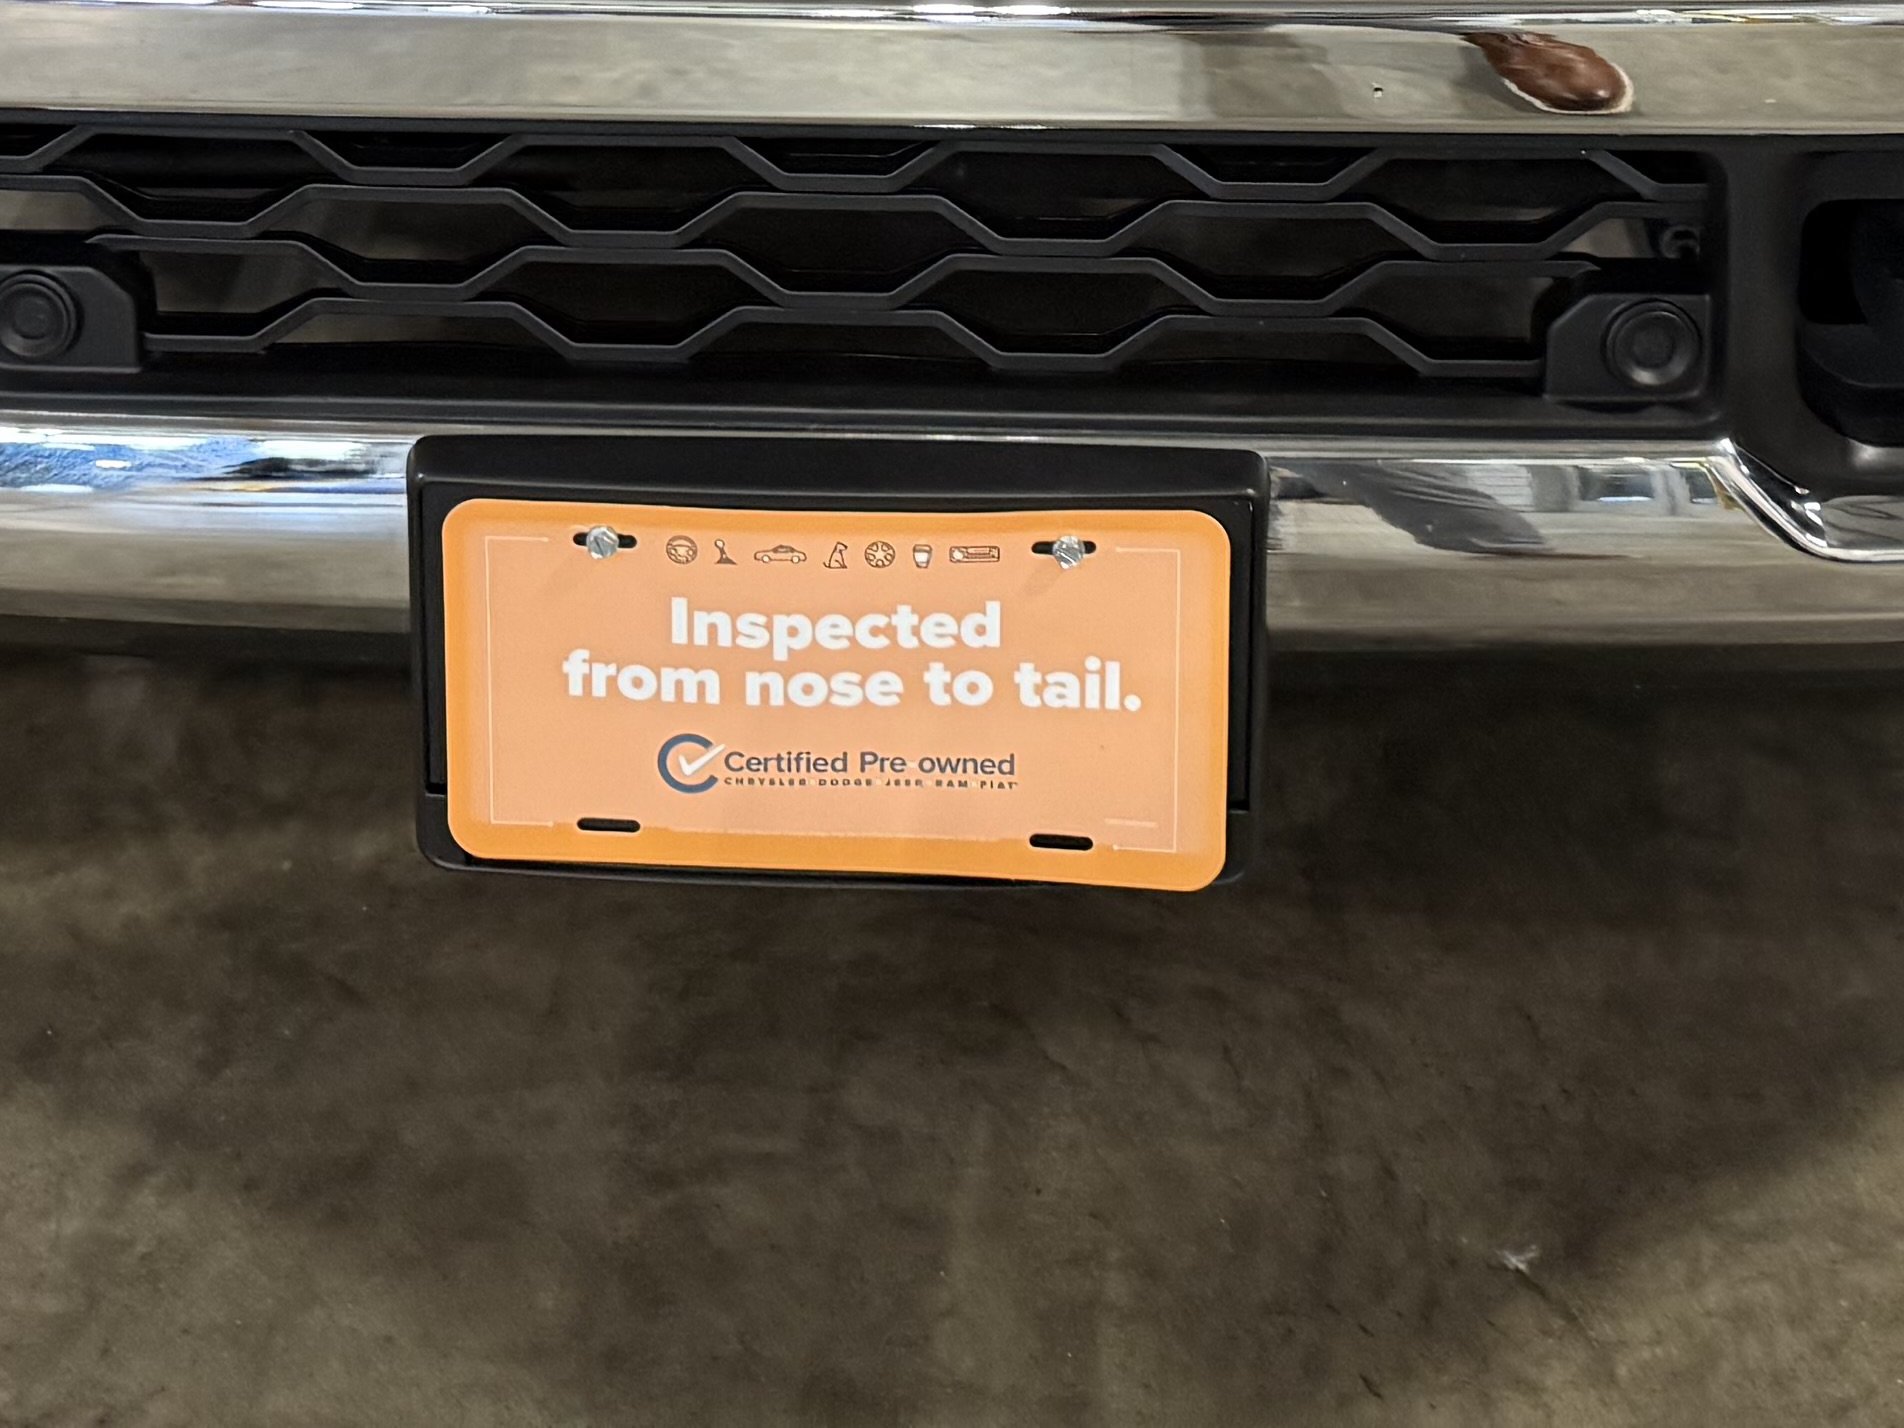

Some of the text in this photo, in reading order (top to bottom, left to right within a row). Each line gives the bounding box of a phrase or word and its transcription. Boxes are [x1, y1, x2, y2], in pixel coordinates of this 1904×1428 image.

[671, 597, 1000, 661] Inspected
[563, 649, 1141, 711] from nose to tail.
[724, 751, 848, 773] Certified
